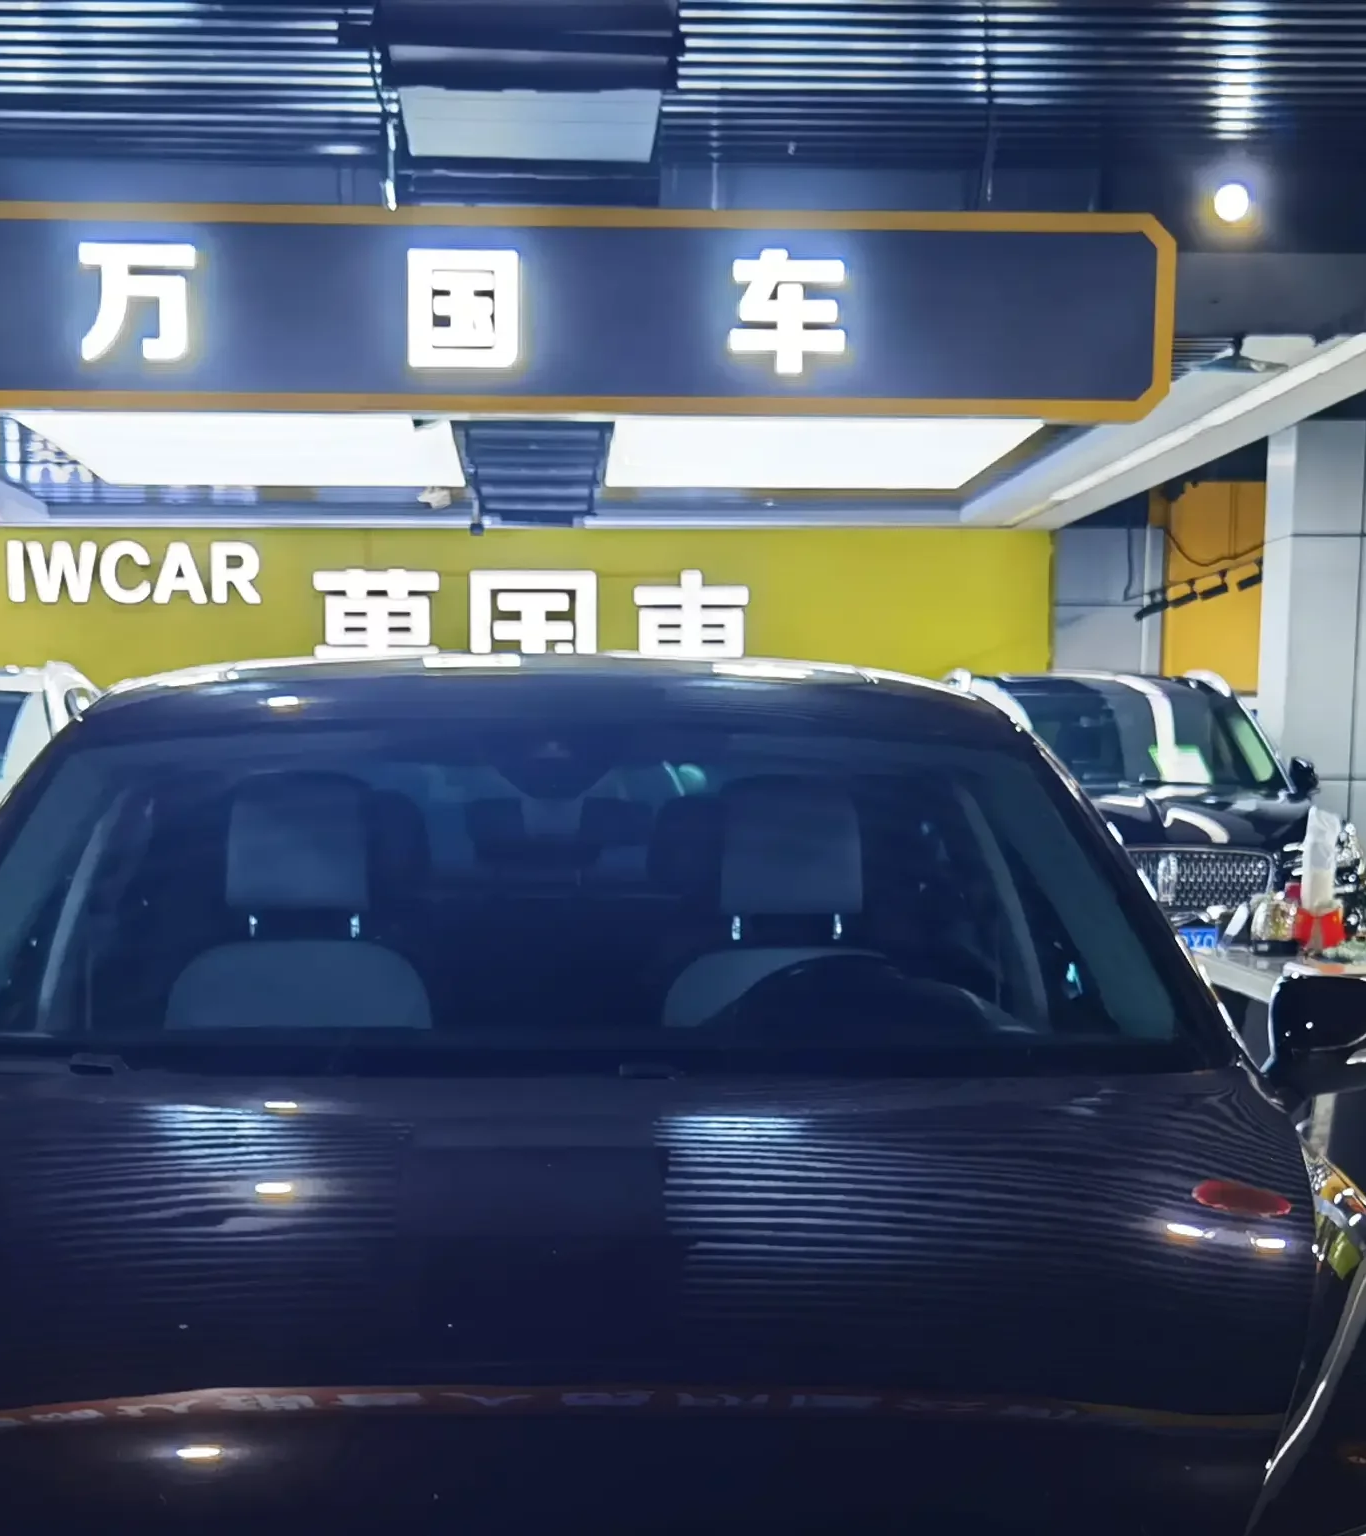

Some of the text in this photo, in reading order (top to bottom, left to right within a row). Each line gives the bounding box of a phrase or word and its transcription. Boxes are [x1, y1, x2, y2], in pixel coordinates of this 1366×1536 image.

[78, 242, 845, 374] 万国车
[6, 540, 263, 604] IWCAR
